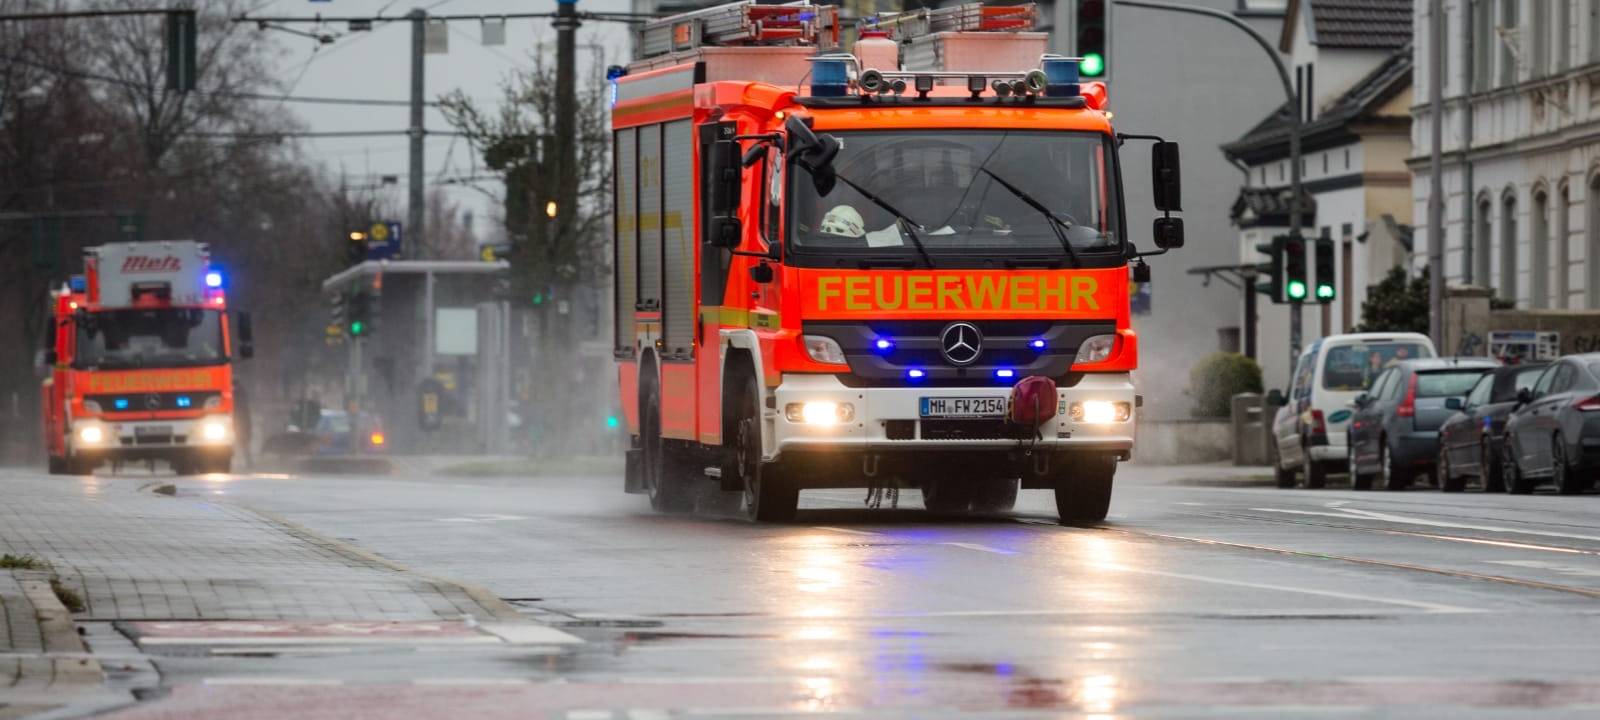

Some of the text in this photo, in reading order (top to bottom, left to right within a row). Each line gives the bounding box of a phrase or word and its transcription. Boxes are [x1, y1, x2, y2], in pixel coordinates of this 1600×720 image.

[121, 255, 182, 273] Metz
[817, 276, 1099, 311] FEUERWEHR
[930, 399, 1003, 413] MH FW 2154
